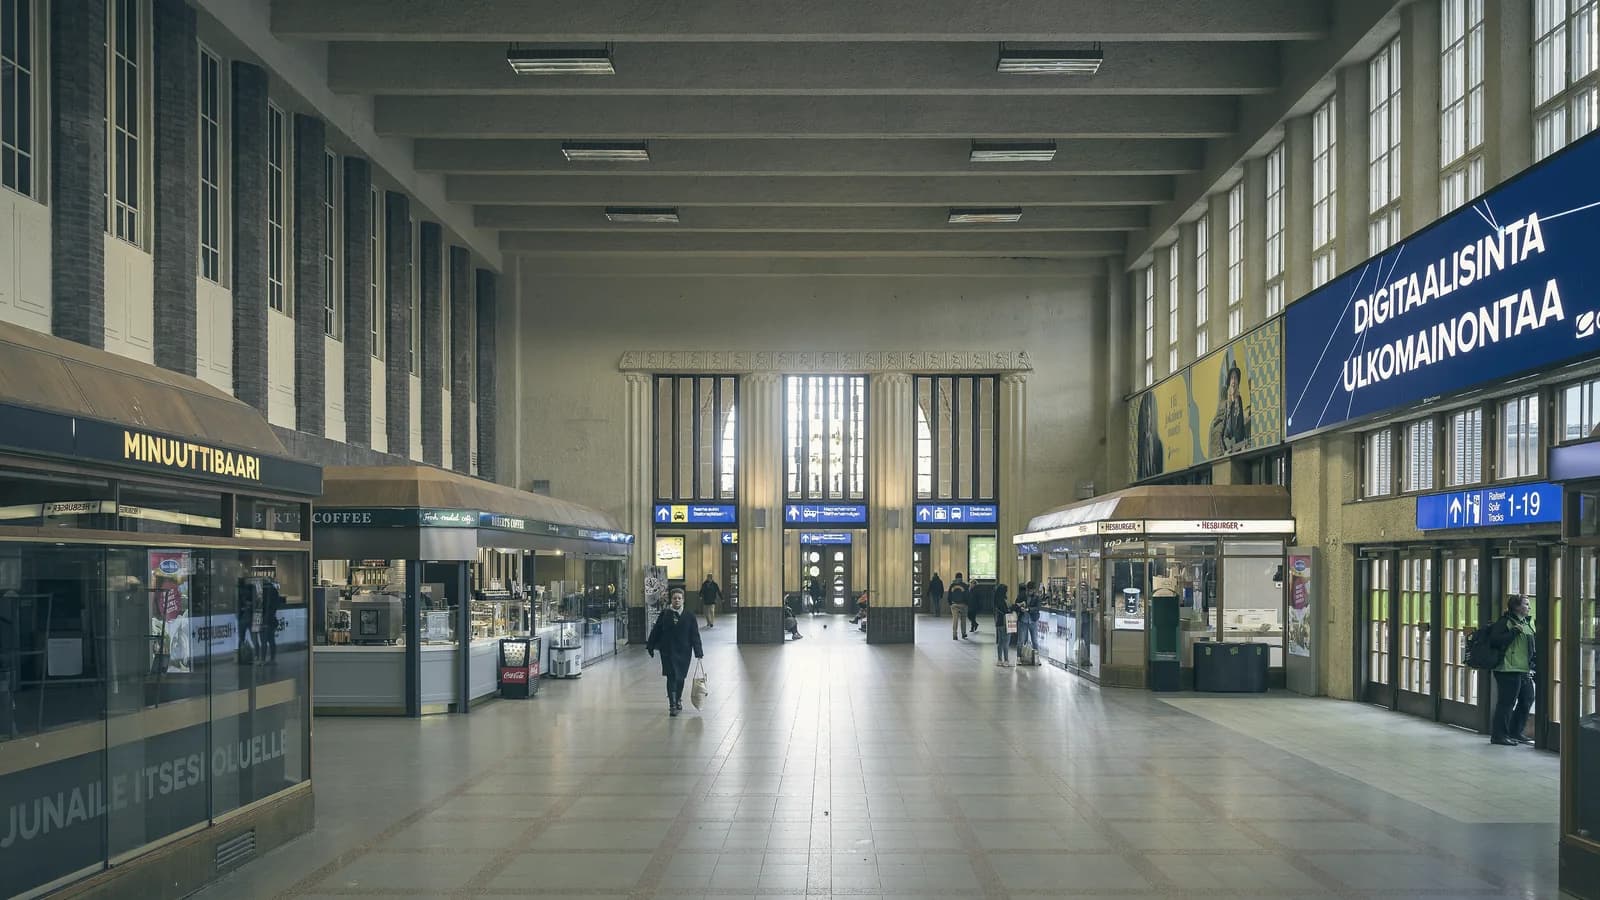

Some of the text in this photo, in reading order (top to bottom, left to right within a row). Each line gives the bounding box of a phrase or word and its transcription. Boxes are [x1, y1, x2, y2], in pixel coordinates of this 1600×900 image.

[1354, 212, 1546, 334] DIGITAALISINTA
[1343, 278, 1565, 391] ULKOMAINONTAA
[124, 431, 260, 481] MINUUTTIBAARI
[1508, 491, 1540, 517] 1-19
[312, 512, 371, 524] COFFEE
[1105, 523, 1137, 531] HESBURGER
[1202, 521, 1239, 530] HESBURGER
[1488, 513, 1505, 522] Tracks
[1, 775, 128, 848] JUNAILE
[135, 752, 206, 804] ITSESI
